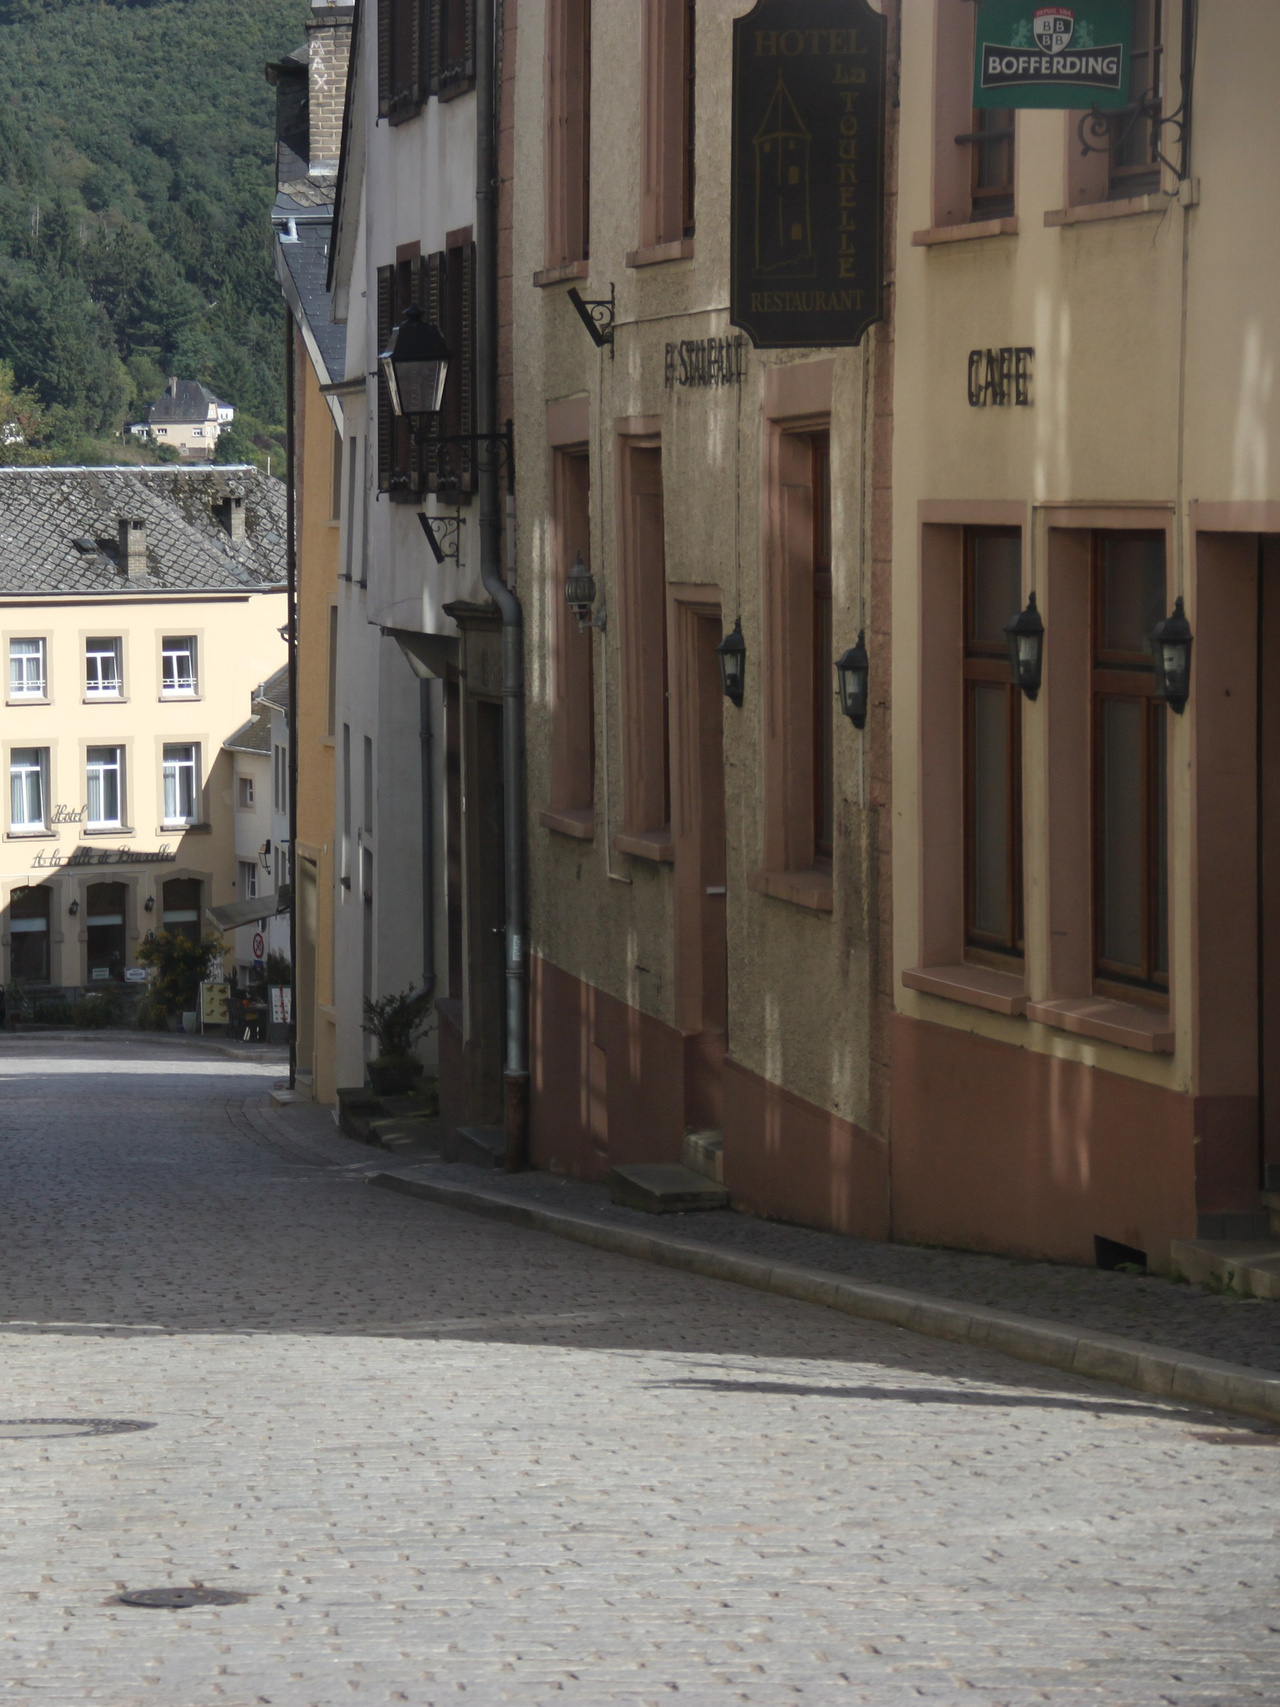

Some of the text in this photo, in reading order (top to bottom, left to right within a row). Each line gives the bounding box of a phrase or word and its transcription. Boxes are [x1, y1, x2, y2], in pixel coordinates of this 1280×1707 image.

[1043, 21, 1065, 32] B B
[753, 29, 868, 57] HOTEL
[1042, 35, 1064, 45] B B
[833, 63, 866, 83] La
[988, 56, 1118, 75] BOFFERDING
[837, 92, 860, 278] TOURELLE
[750, 289, 865, 313] RESTAURANT
[967, 347, 1034, 407] CAFE
[50, 848, 62, 867] la
[97, 849, 114, 865] de
[115, 844, 177, 865] Bruxelles
